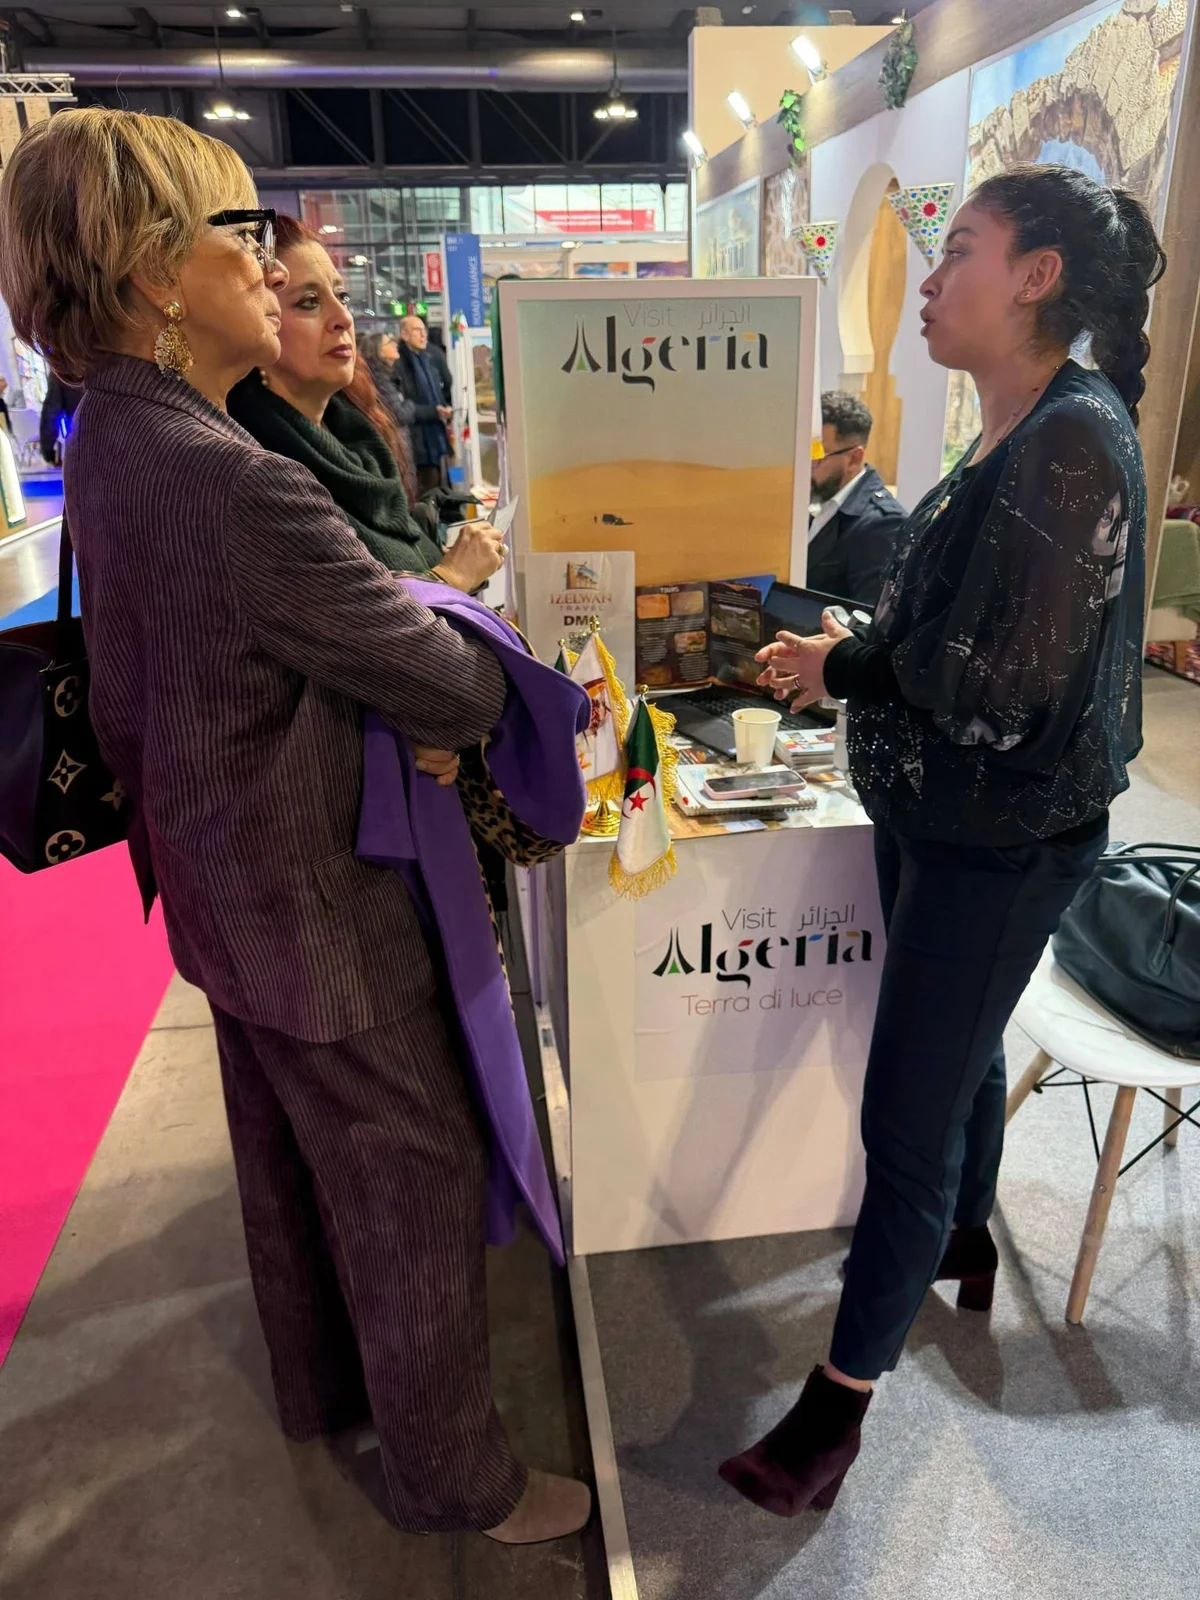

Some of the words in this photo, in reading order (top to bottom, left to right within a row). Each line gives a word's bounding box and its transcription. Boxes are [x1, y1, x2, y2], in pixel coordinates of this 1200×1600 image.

[467, 256, 480, 299] ALLIANCE
[623, 303, 675, 327] Visit
[699, 303, 751, 330] الجزائر
[561, 313, 769, 393] Algeria
[722, 907, 776, 930] Visit
[798, 904, 855, 931] الجزائر
[652, 922, 872, 989] Algeria
[681, 993, 750, 1016] Terra
[759, 989, 782, 1009] di
[791, 988, 843, 1009] luce
